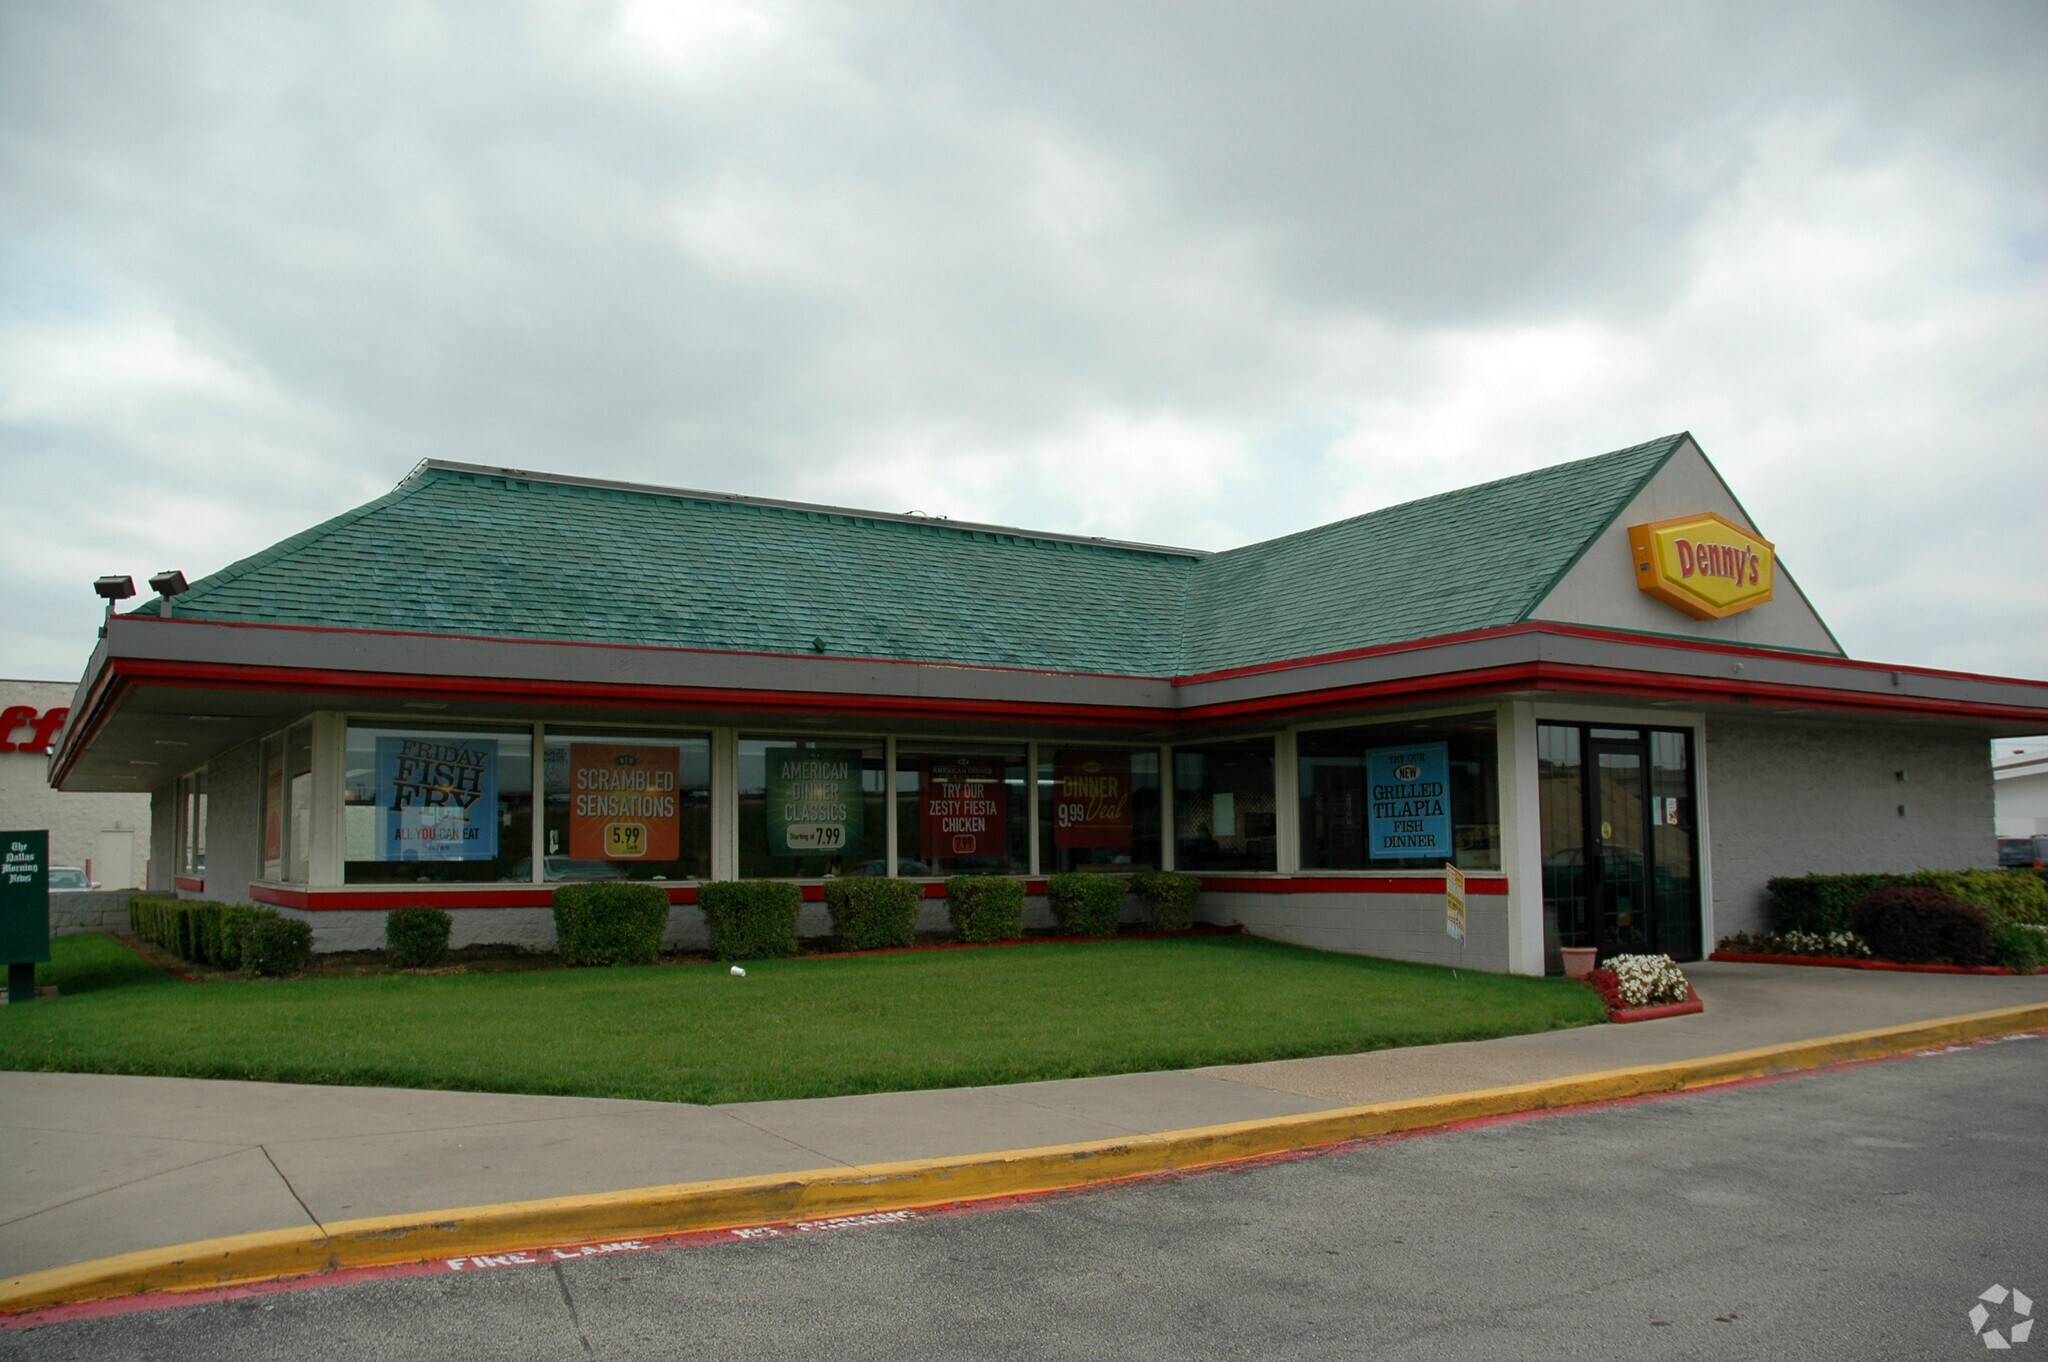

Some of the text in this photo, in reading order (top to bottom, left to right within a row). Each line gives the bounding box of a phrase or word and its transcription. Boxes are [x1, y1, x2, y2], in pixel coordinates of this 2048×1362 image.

[1674, 538, 1760, 588] Denny's
[399, 739, 488, 767] FRIDAY
[1389, 753, 1425, 764] TRY OUR
[393, 756, 484, 793] FISH
[781, 761, 848, 780] AMERICAN
[1399, 766, 1417, 779] NEW
[576, 768, 675, 792] SCRAMBLED
[1063, 775, 1119, 798] DINNER
[792, 783, 839, 801] DINNER
[941, 783, 985, 798] TRY OUR
[1373, 782, 1443, 800] GRILLED
[389, 782, 481, 821] FRY
[576, 794, 675, 817] SENSATIONS
[929, 800, 997, 815] ZESTY FIESTA
[1058, 793, 1128, 828] 9.99 Deal
[1373, 800, 1444, 818] TILAPIA
[784, 803, 847, 822] CLASSICS
[942, 817, 986, 832] CHICKEN
[1393, 819, 1424, 833] FISH
[395, 828, 480, 840] ALL YOU CAN EAT
[613, 827, 640, 844] 5.99
[816, 827, 840, 845] 7.99
[1383, 834, 1436, 848] DINNER
[5, 852, 35, 863] Dallas
[2, 863, 39, 874] Morning
[446, 1252, 535, 1271] FIRE
[552, 1240, 651, 1259] LANE
